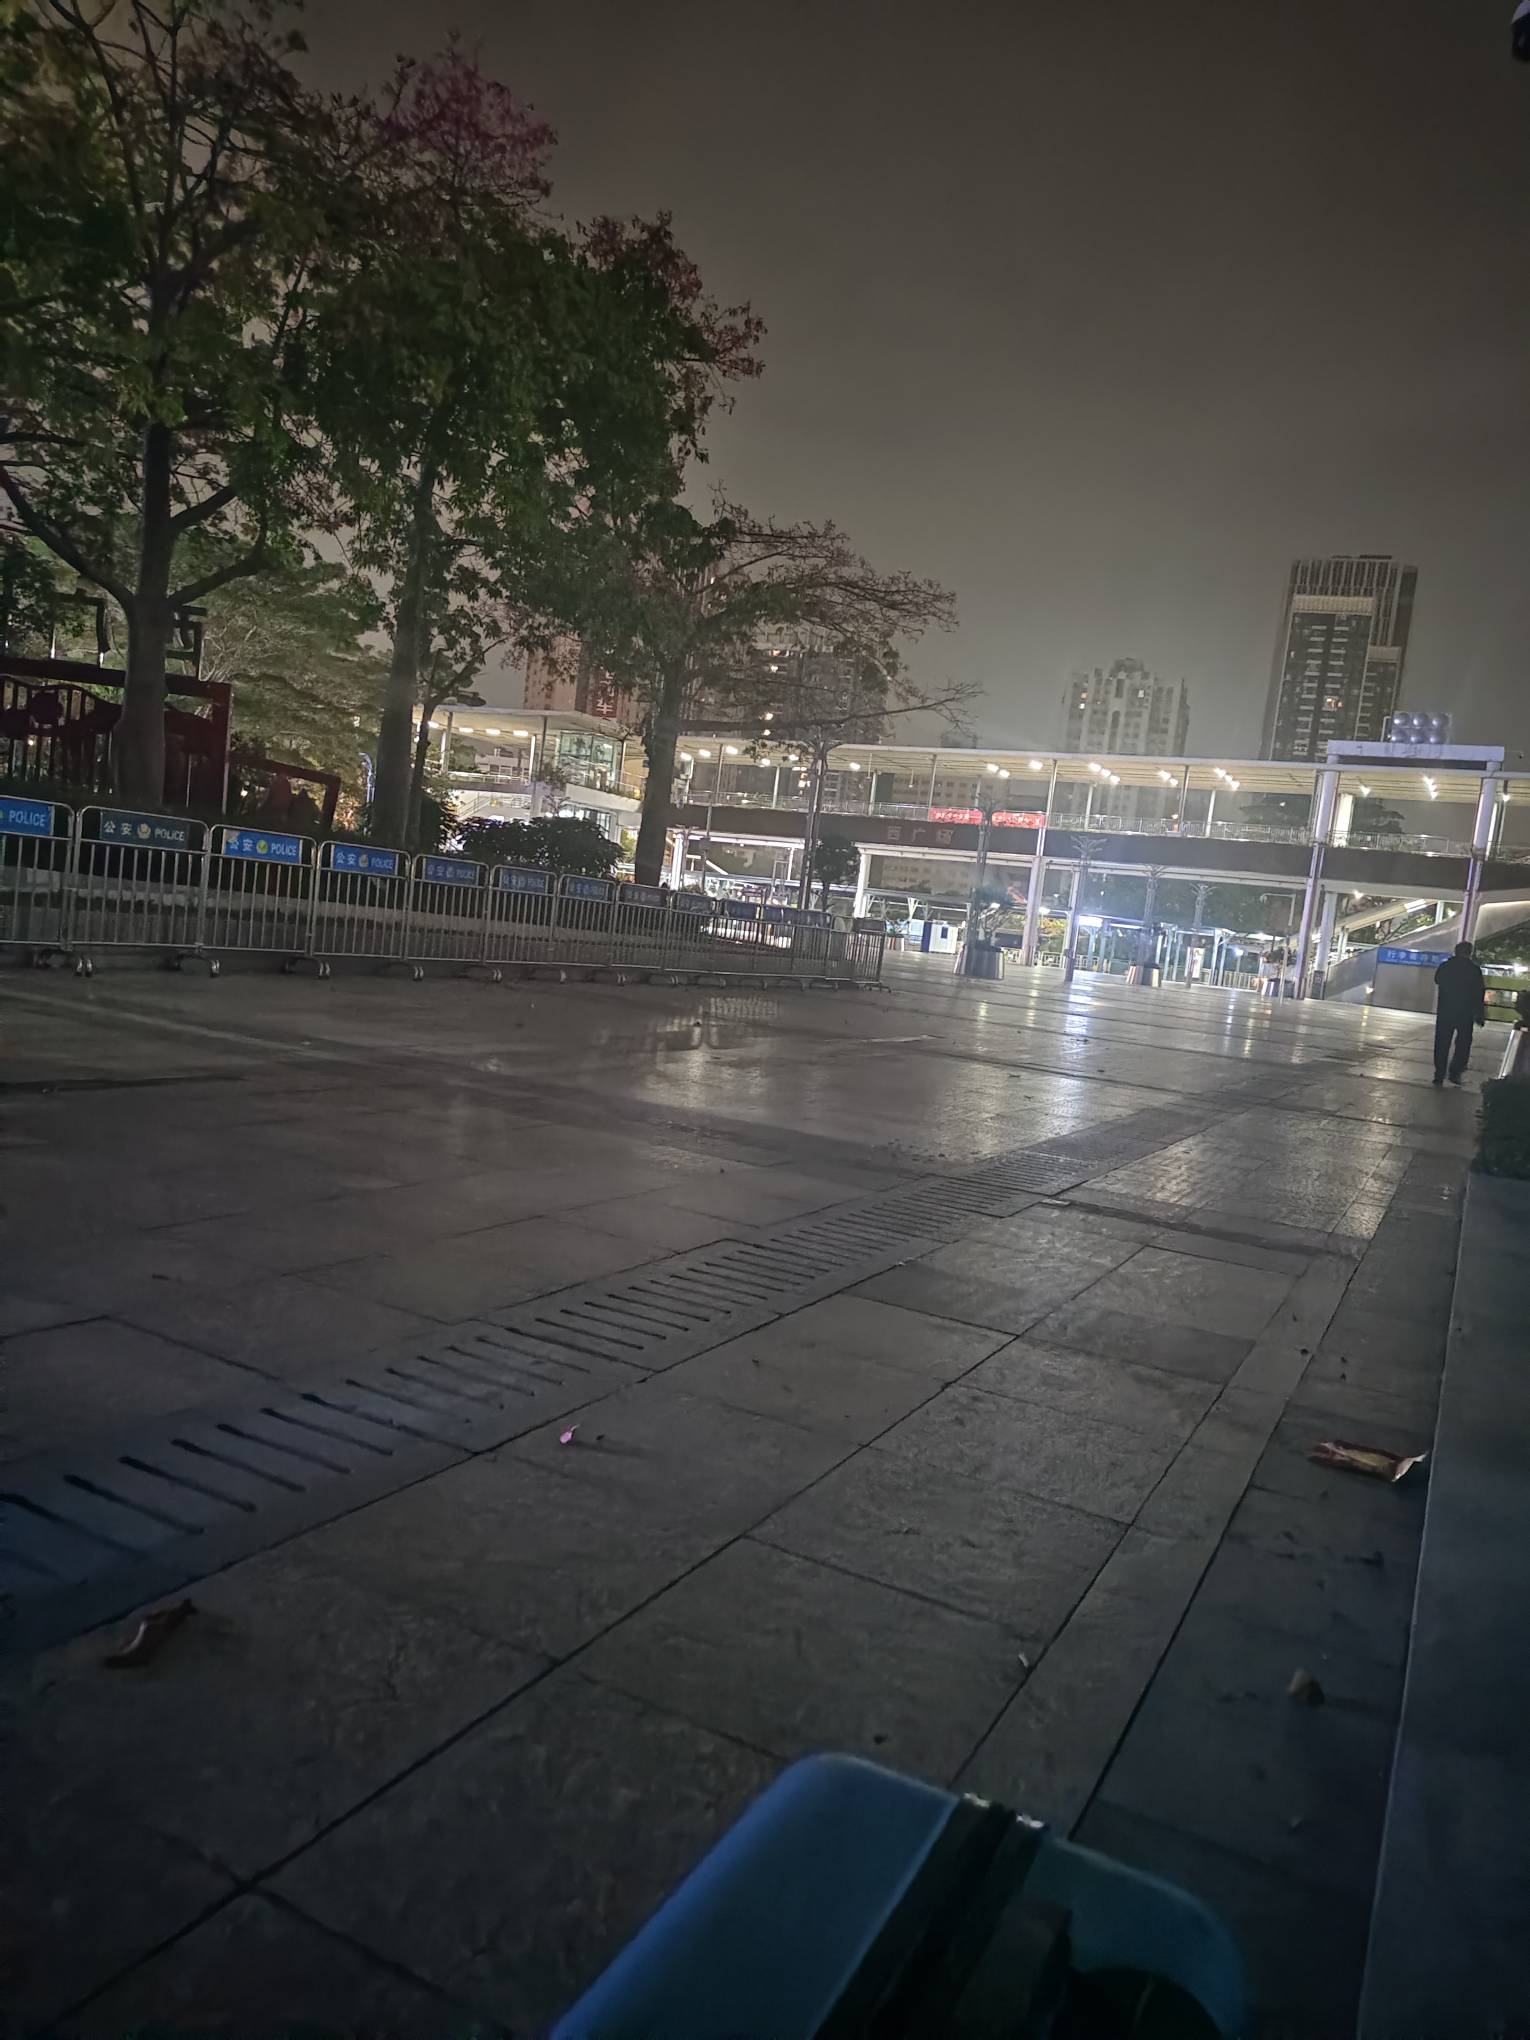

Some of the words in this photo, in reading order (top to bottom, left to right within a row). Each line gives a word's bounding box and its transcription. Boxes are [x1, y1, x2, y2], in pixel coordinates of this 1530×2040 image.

[8, 809, 47, 828] POLICE
[103, 820, 133, 836] 公安
[154, 827, 186, 842] POLICE
[227, 837, 254, 852] 公安
[270, 842, 297, 857] POLICE
[336, 851, 358, 866] 公安
[370, 857, 394, 870] POLICE
